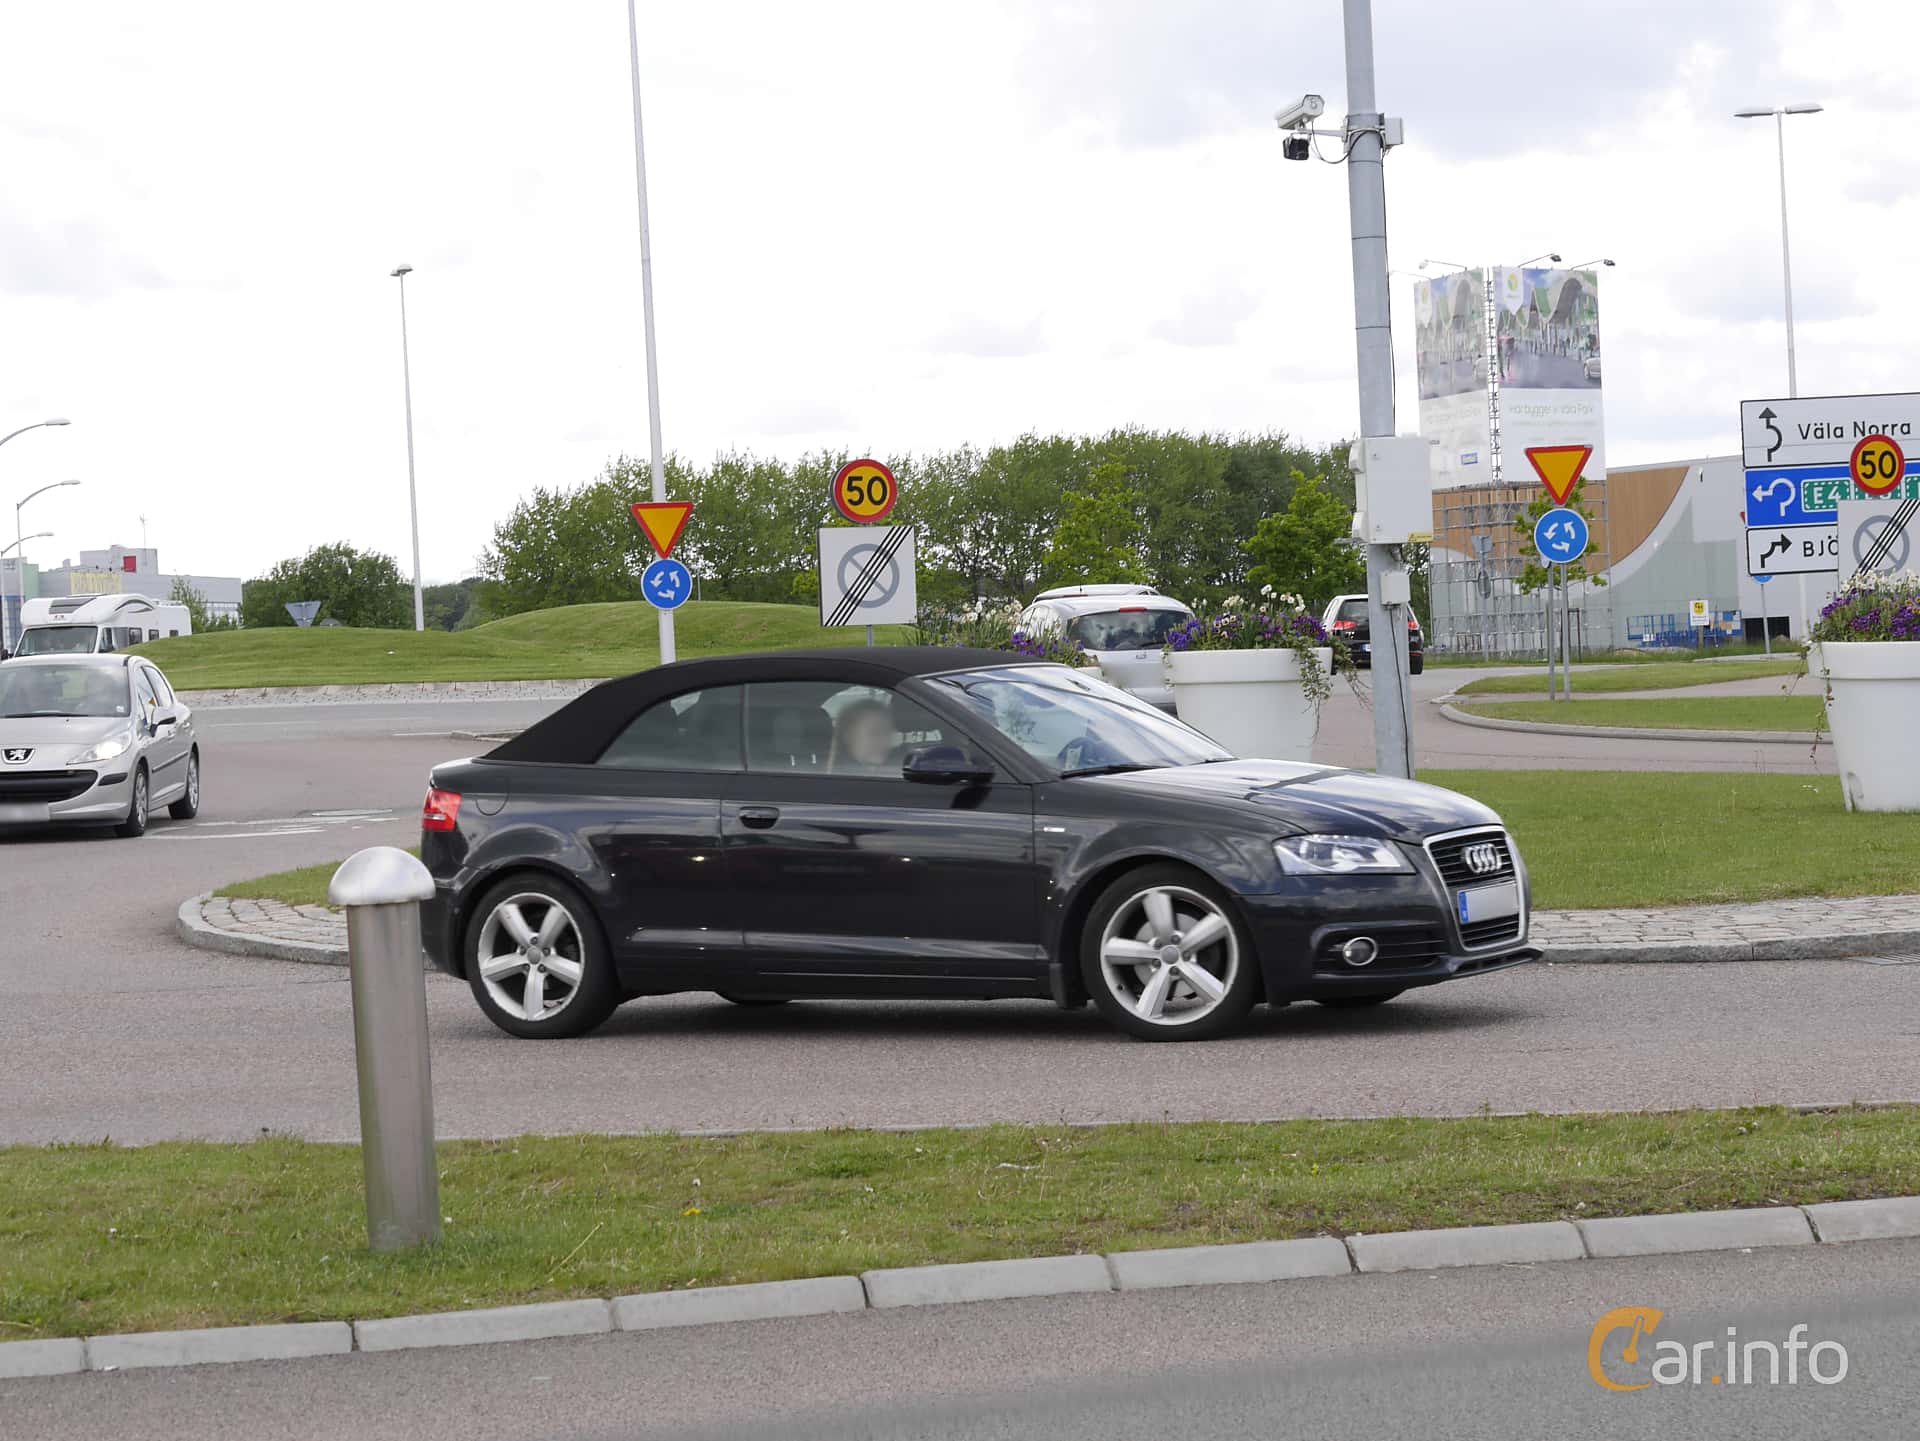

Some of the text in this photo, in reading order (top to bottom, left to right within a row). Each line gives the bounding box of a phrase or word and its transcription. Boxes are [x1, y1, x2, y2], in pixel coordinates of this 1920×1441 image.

[1798, 420, 1911, 440] Väla Norra
[1860, 450, 1897, 480] 50
[847, 475, 888, 507] 50
[1812, 485, 1841, 505] E4
